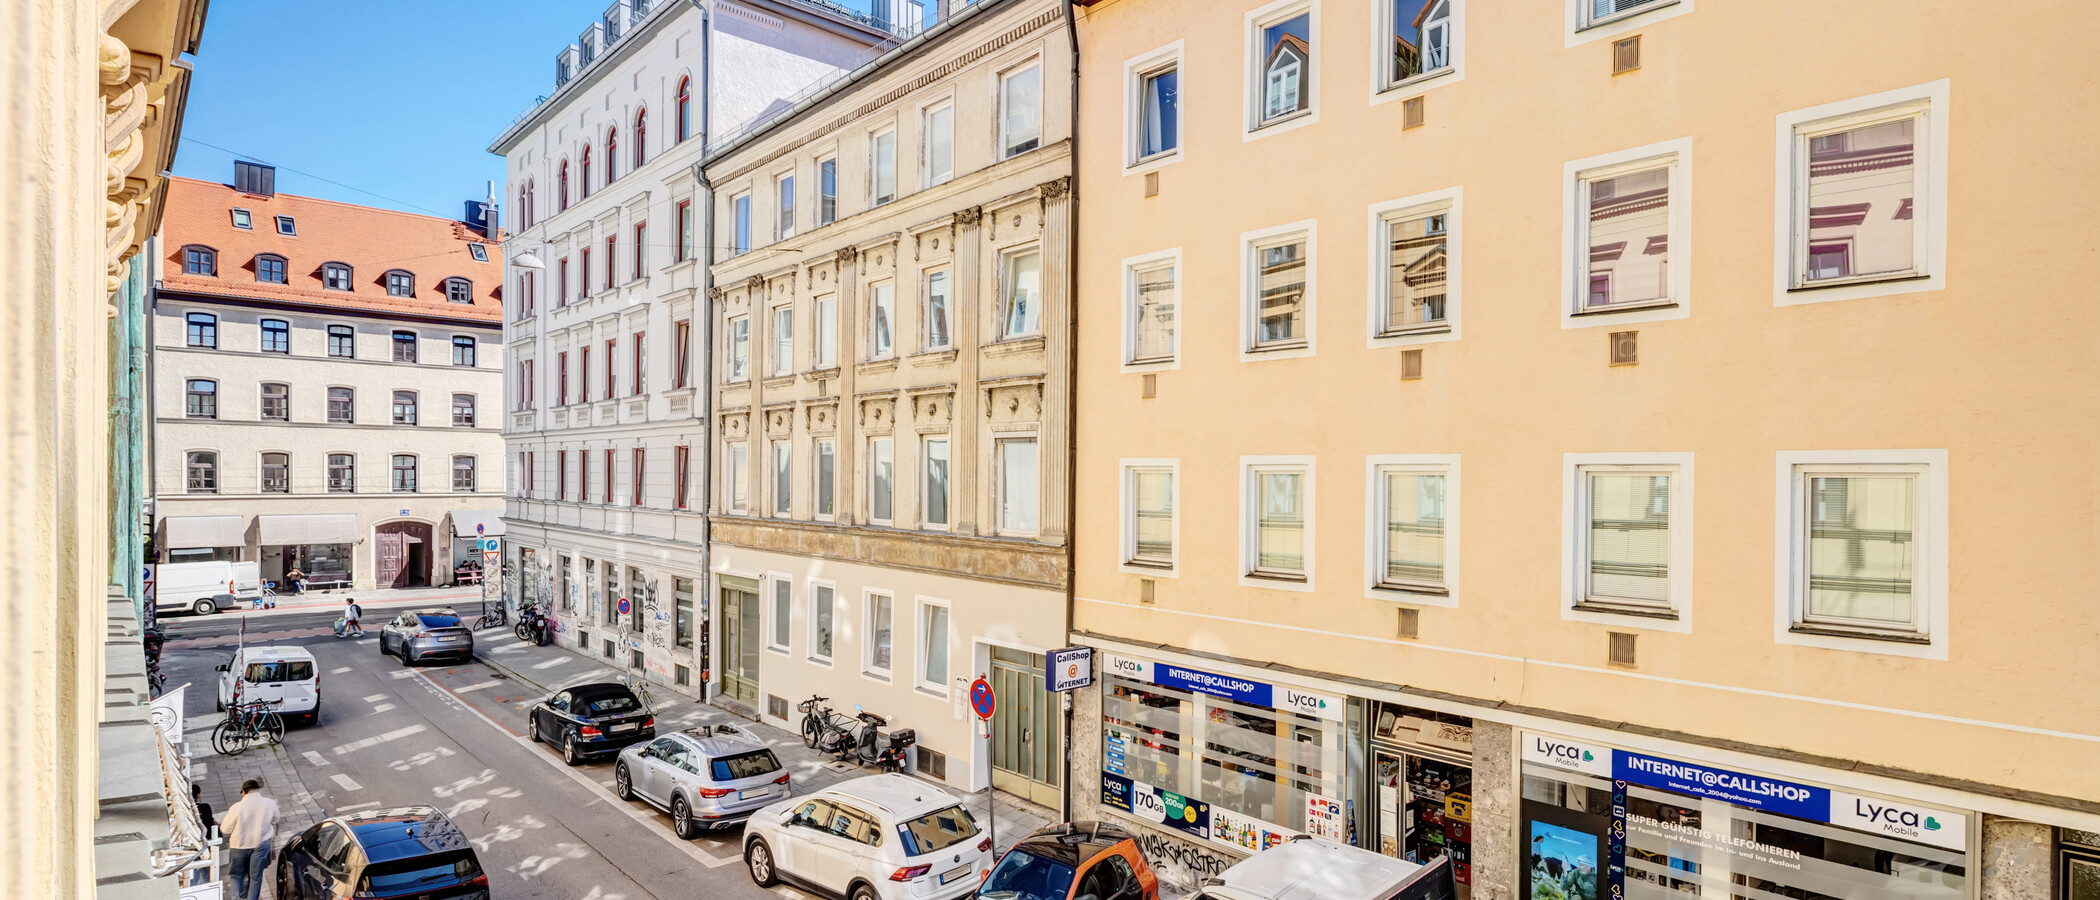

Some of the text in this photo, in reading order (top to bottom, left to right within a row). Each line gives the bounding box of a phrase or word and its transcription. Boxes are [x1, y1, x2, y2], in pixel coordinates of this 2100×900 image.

[1057, 652, 1089, 663] CallShop
[1114, 657, 1135, 671] Lyca
[1169, 668, 1254, 693] INTERNET@CALLSHOP
[1288, 691, 1317, 707] Lyca
[1301, 706, 1316, 714] Mobile
[1537, 737, 1579, 759] Lyca
[1555, 757, 1579, 768] Mobile
[1104, 777, 1122, 791] Lyca
[1628, 756, 1810, 802] INTERNET@CALLSHOP
[1856, 798, 1919, 827] Lyca
[1626, 813, 1800, 860] SUPER GÜNSTIG TELEFONIEREN
[1883, 824, 1918, 838] Mobile
[1638, 826, 1662, 837] Familie
[1679, 836, 1713, 849] Freunden
[1738, 850, 1754, 859] und
[1768, 857, 1801, 870] Ausland
